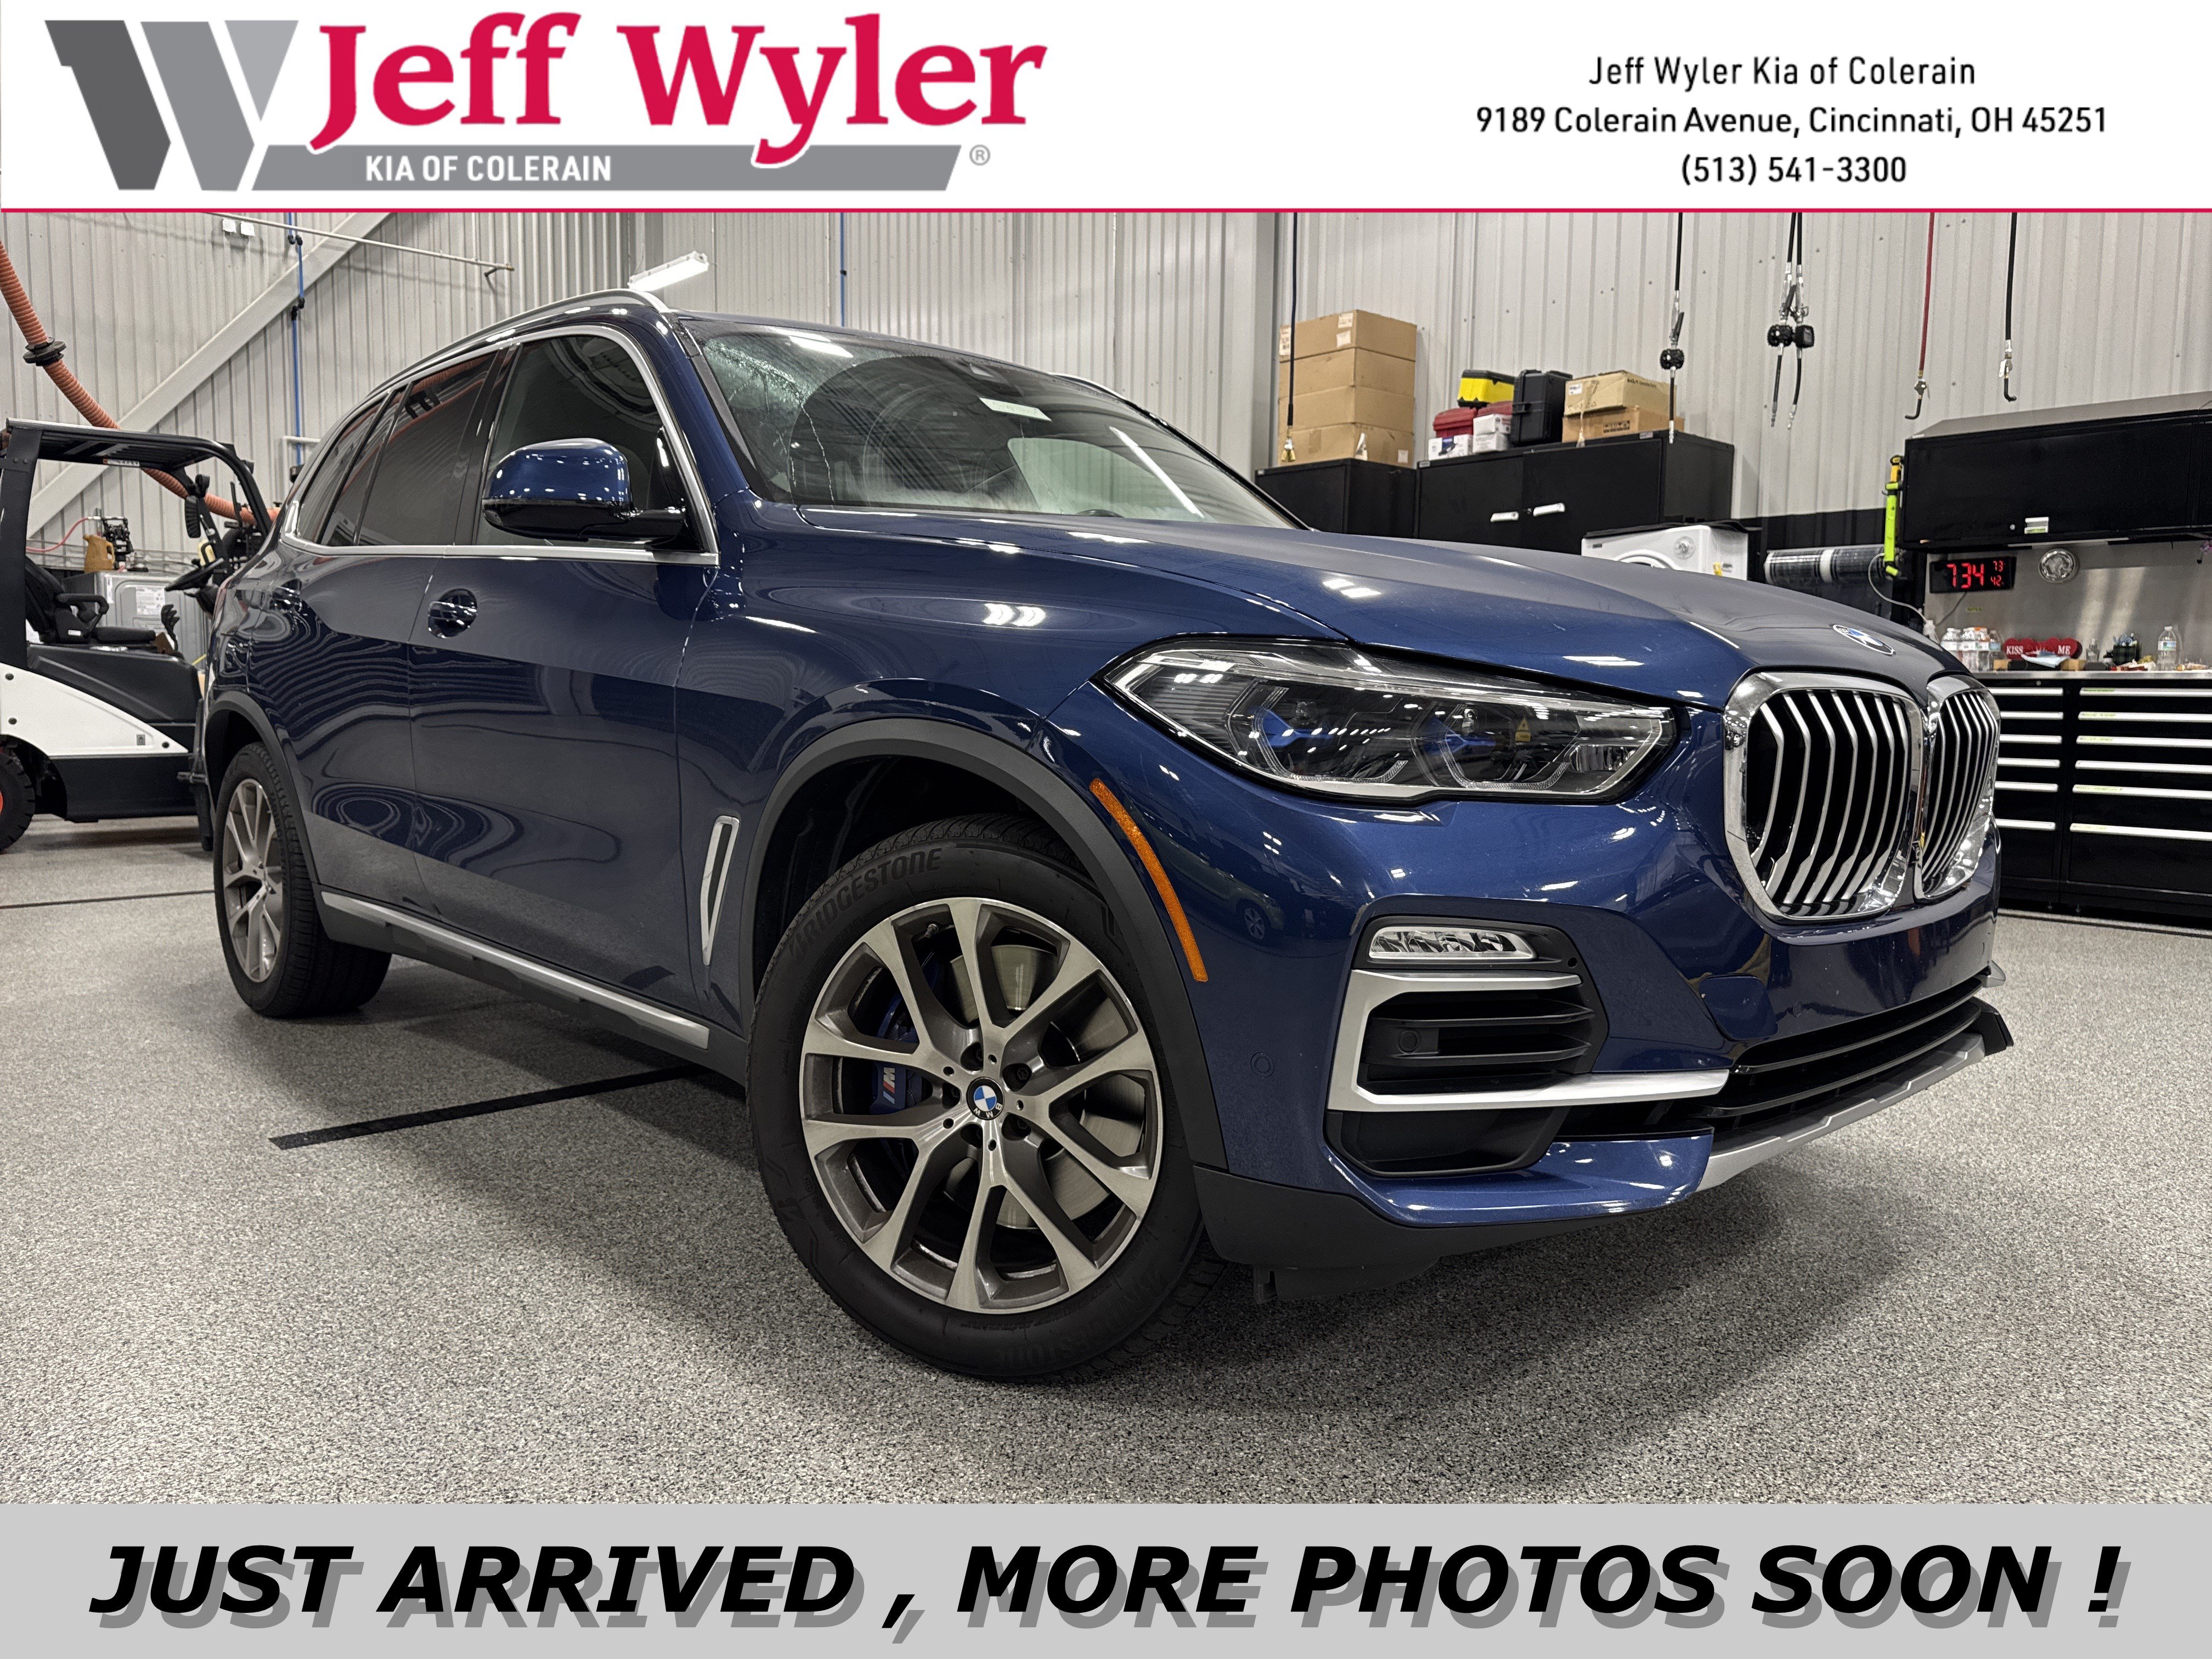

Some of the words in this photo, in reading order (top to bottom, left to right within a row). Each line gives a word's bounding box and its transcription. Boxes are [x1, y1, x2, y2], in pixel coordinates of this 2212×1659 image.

[1993, 560, 2004, 572] 73
[2006, 645, 2024, 656] KISS
[2057, 645, 2072, 655] ME
[787, 847, 943, 958] BRIDGESTONE
[973, 1102, 1003, 1119] BMW
